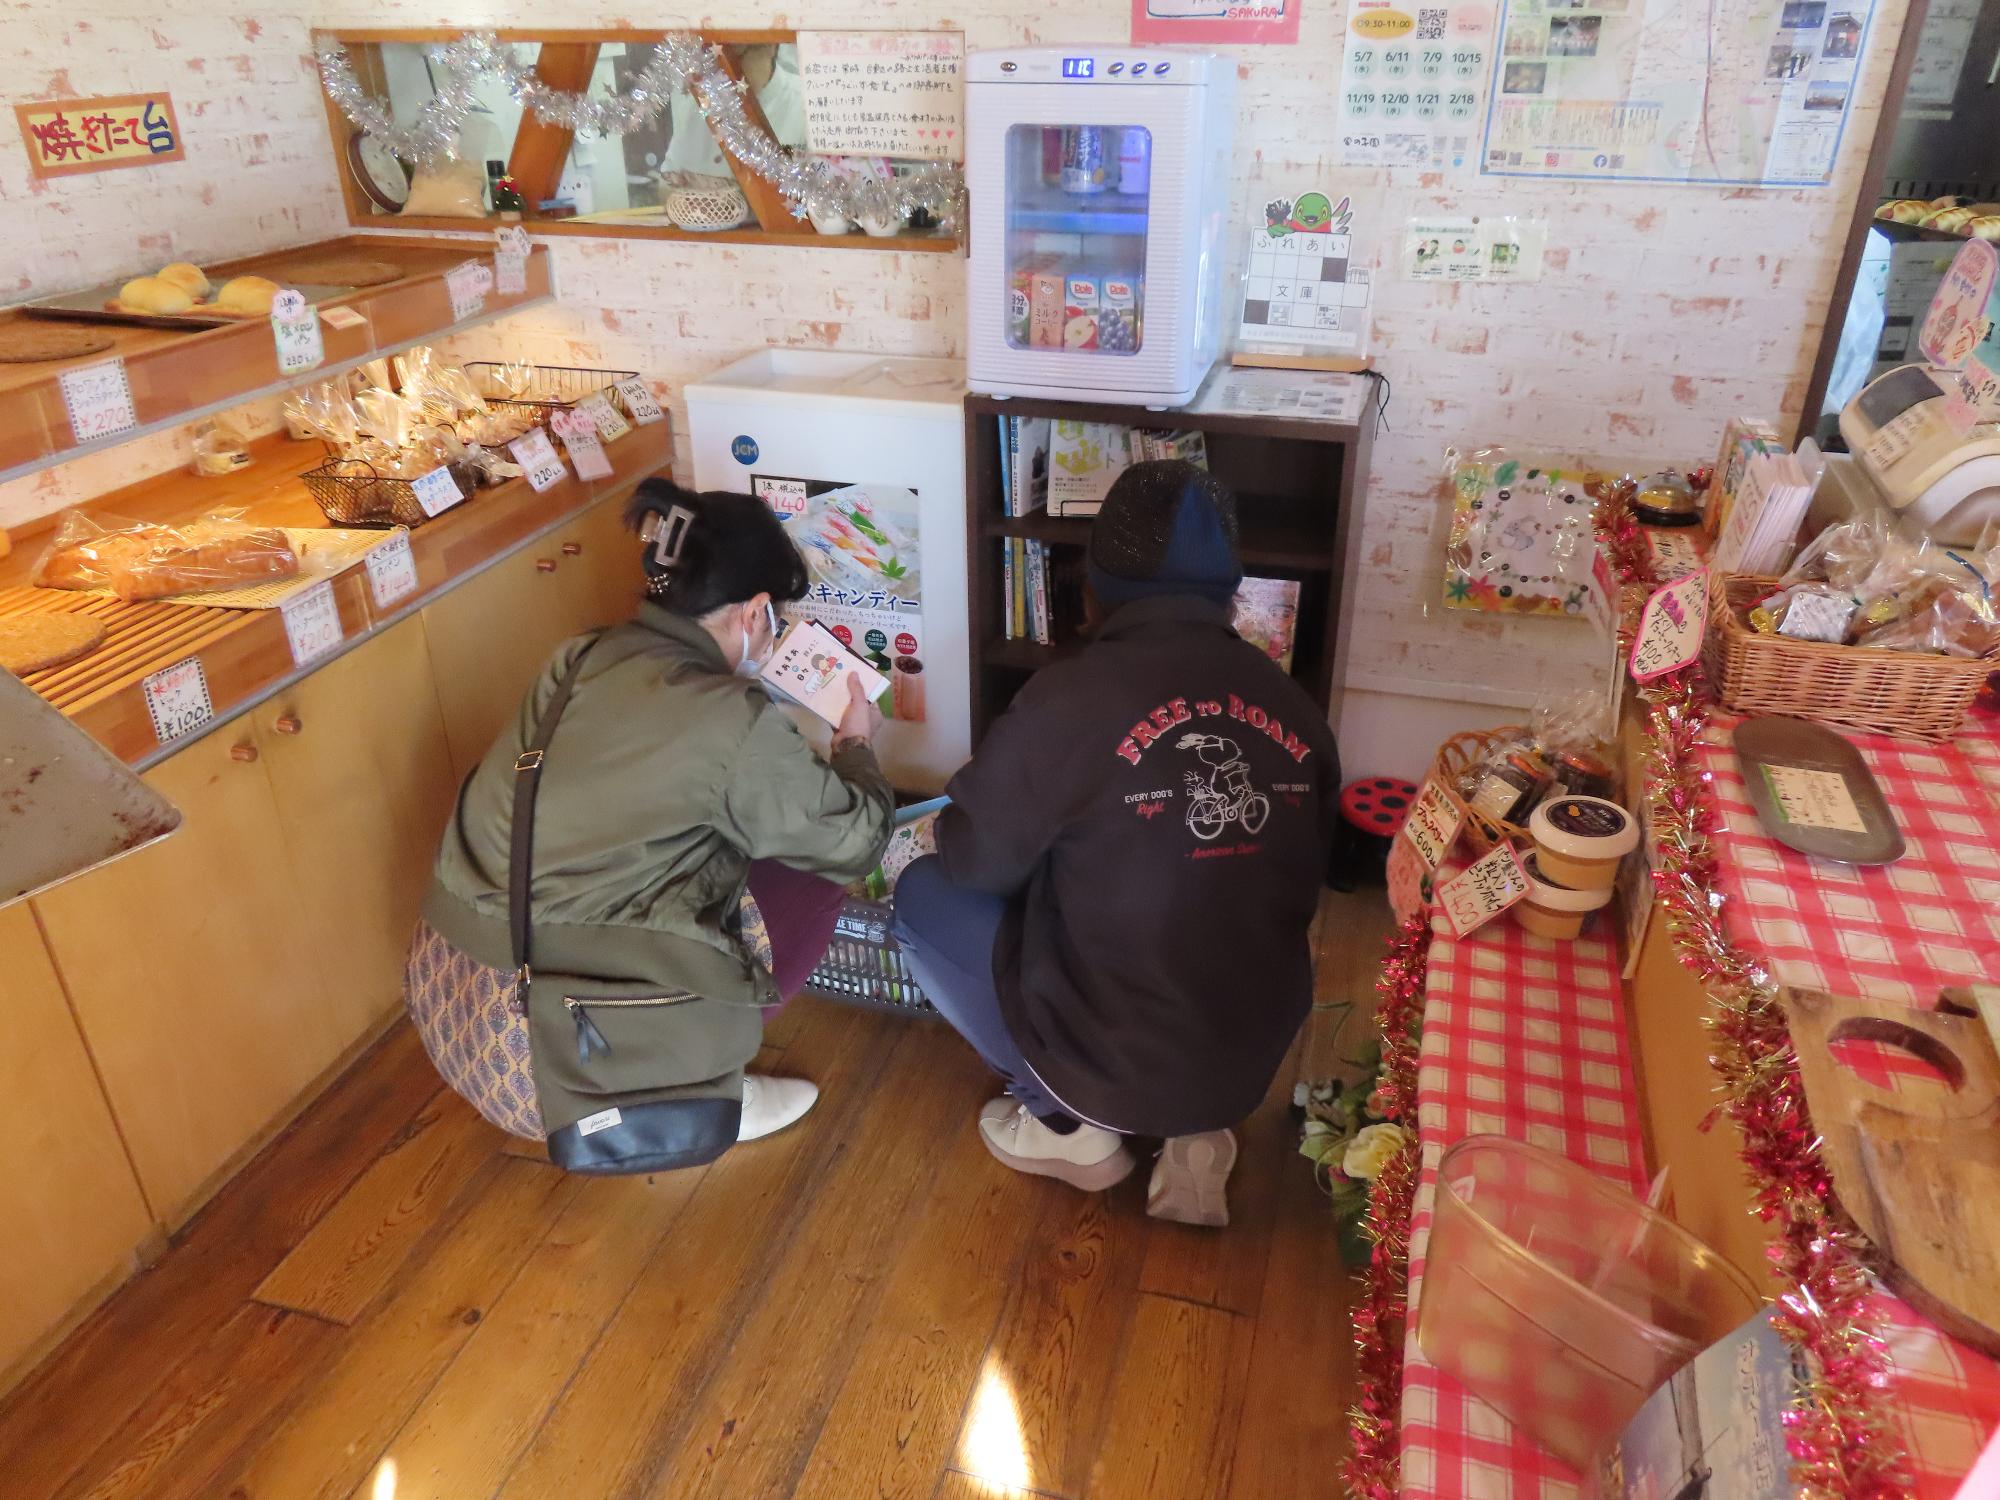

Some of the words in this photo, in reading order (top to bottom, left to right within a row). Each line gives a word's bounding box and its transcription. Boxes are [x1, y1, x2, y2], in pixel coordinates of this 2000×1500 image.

[1227, 8, 1280, 19] SAKURA
[1354, 51, 1373, 62] 5/7
[1385, 51, 1409, 62] 6/11
[1423, 52, 1442, 62] 7/9
[1452, 53, 1481, 63] 10/15
[1346, 93, 1375, 104] 11/19
[1381, 93, 1409, 104] 12/10
[1416, 94, 1440, 104] 1/21
[1449, 94, 1475, 105] 2/18
[1257, 235, 1345, 251] ふれあい
[1074, 284, 1093, 295] Dole
[1110, 285, 1128, 295] Dole
[1276, 284, 1313, 299] 文庫
[733, 438, 759, 457] JCM
[1115, 697, 1192, 766] FREE
[1196, 700, 1222, 717] TO
[1227, 694, 1312, 764] ROAM
[1124, 792, 1149, 804] EVERY
[1151, 789, 1174, 800] DOG'S
